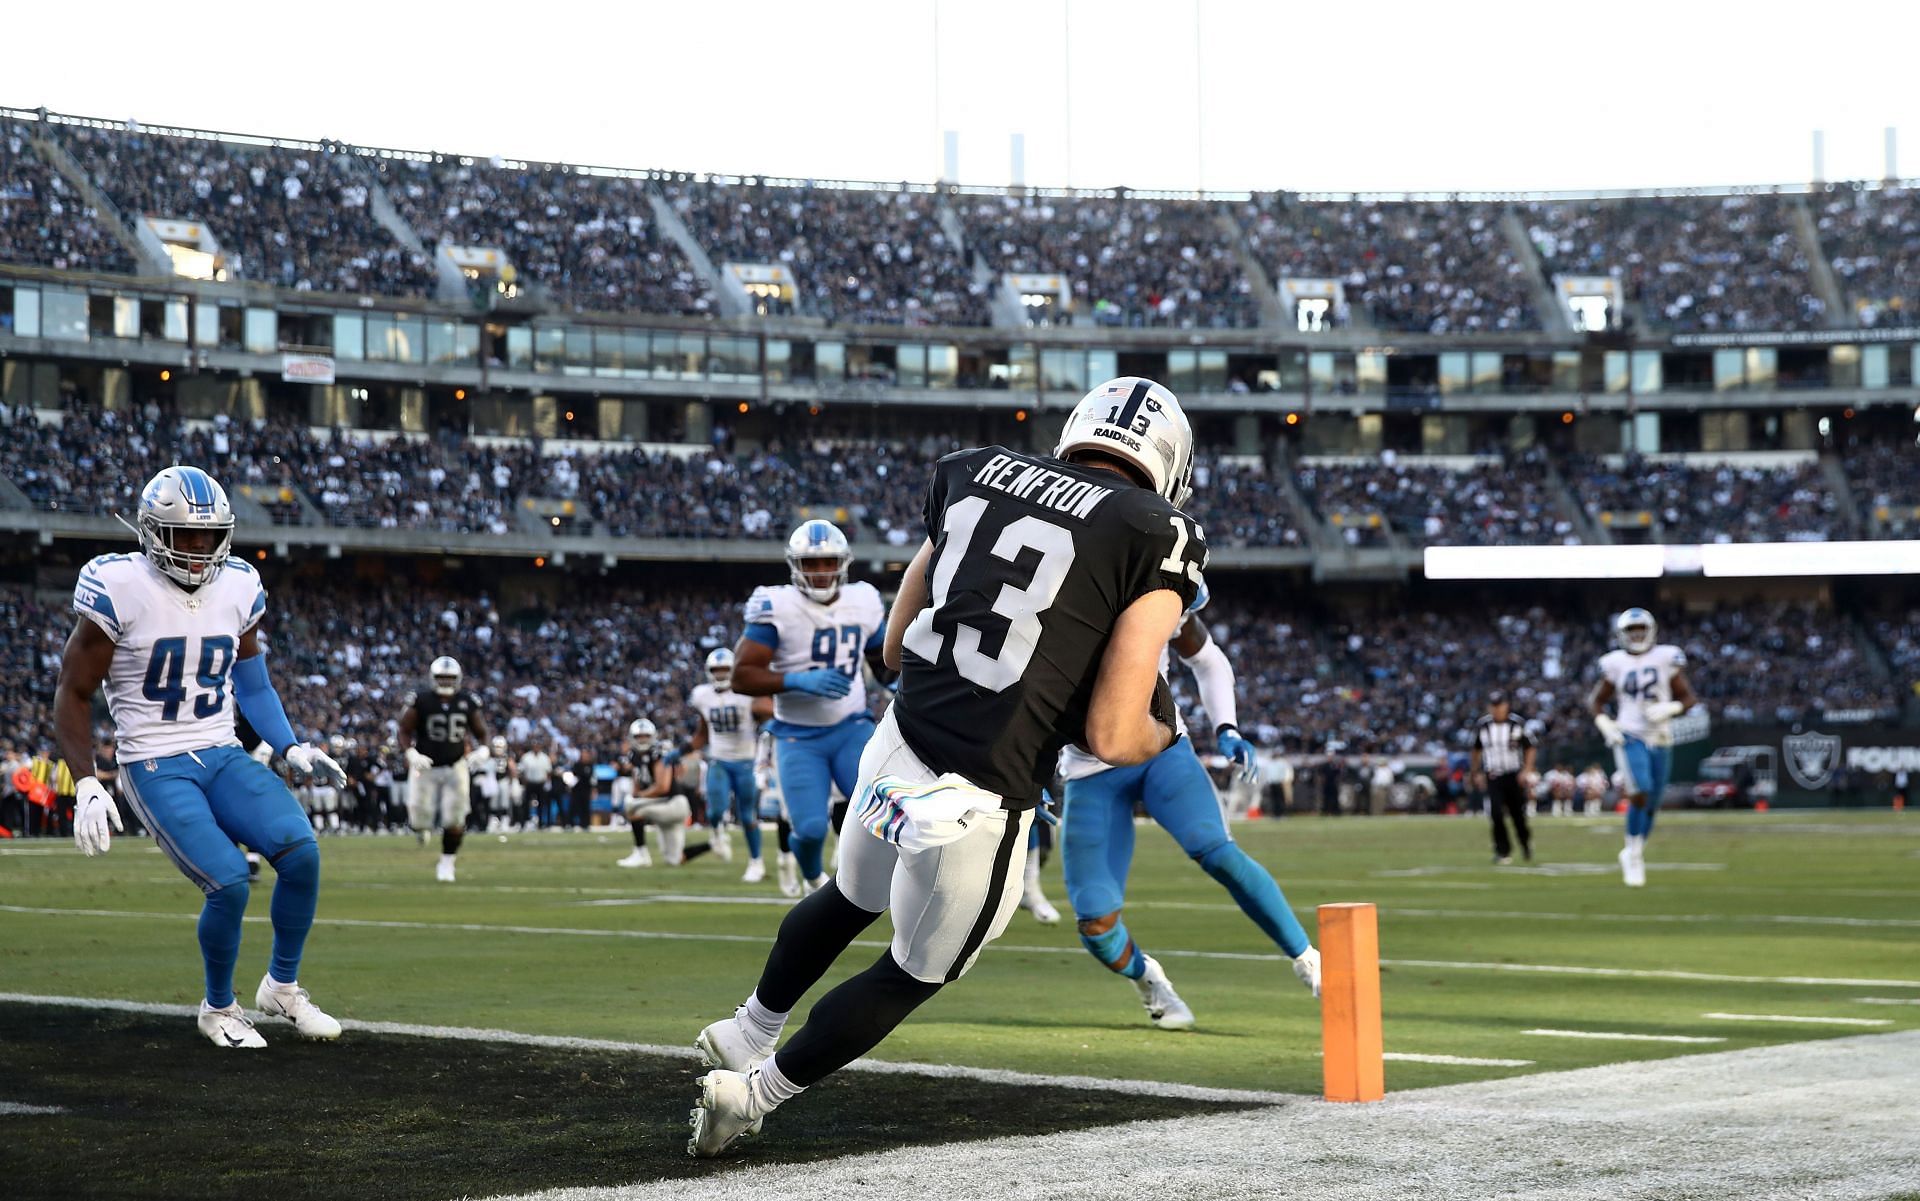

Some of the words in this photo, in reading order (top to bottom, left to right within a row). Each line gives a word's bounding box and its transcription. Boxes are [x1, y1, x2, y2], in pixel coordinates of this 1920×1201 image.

[1093, 428, 1142, 452] RAIDERS
[973, 454, 1114, 520] RENFROW
[902, 495, 1076, 693] 13
[142, 634, 234, 721] 49
[811, 625, 862, 681] 93
[1624, 668, 1659, 699] 42
[426, 713, 468, 743] 66
